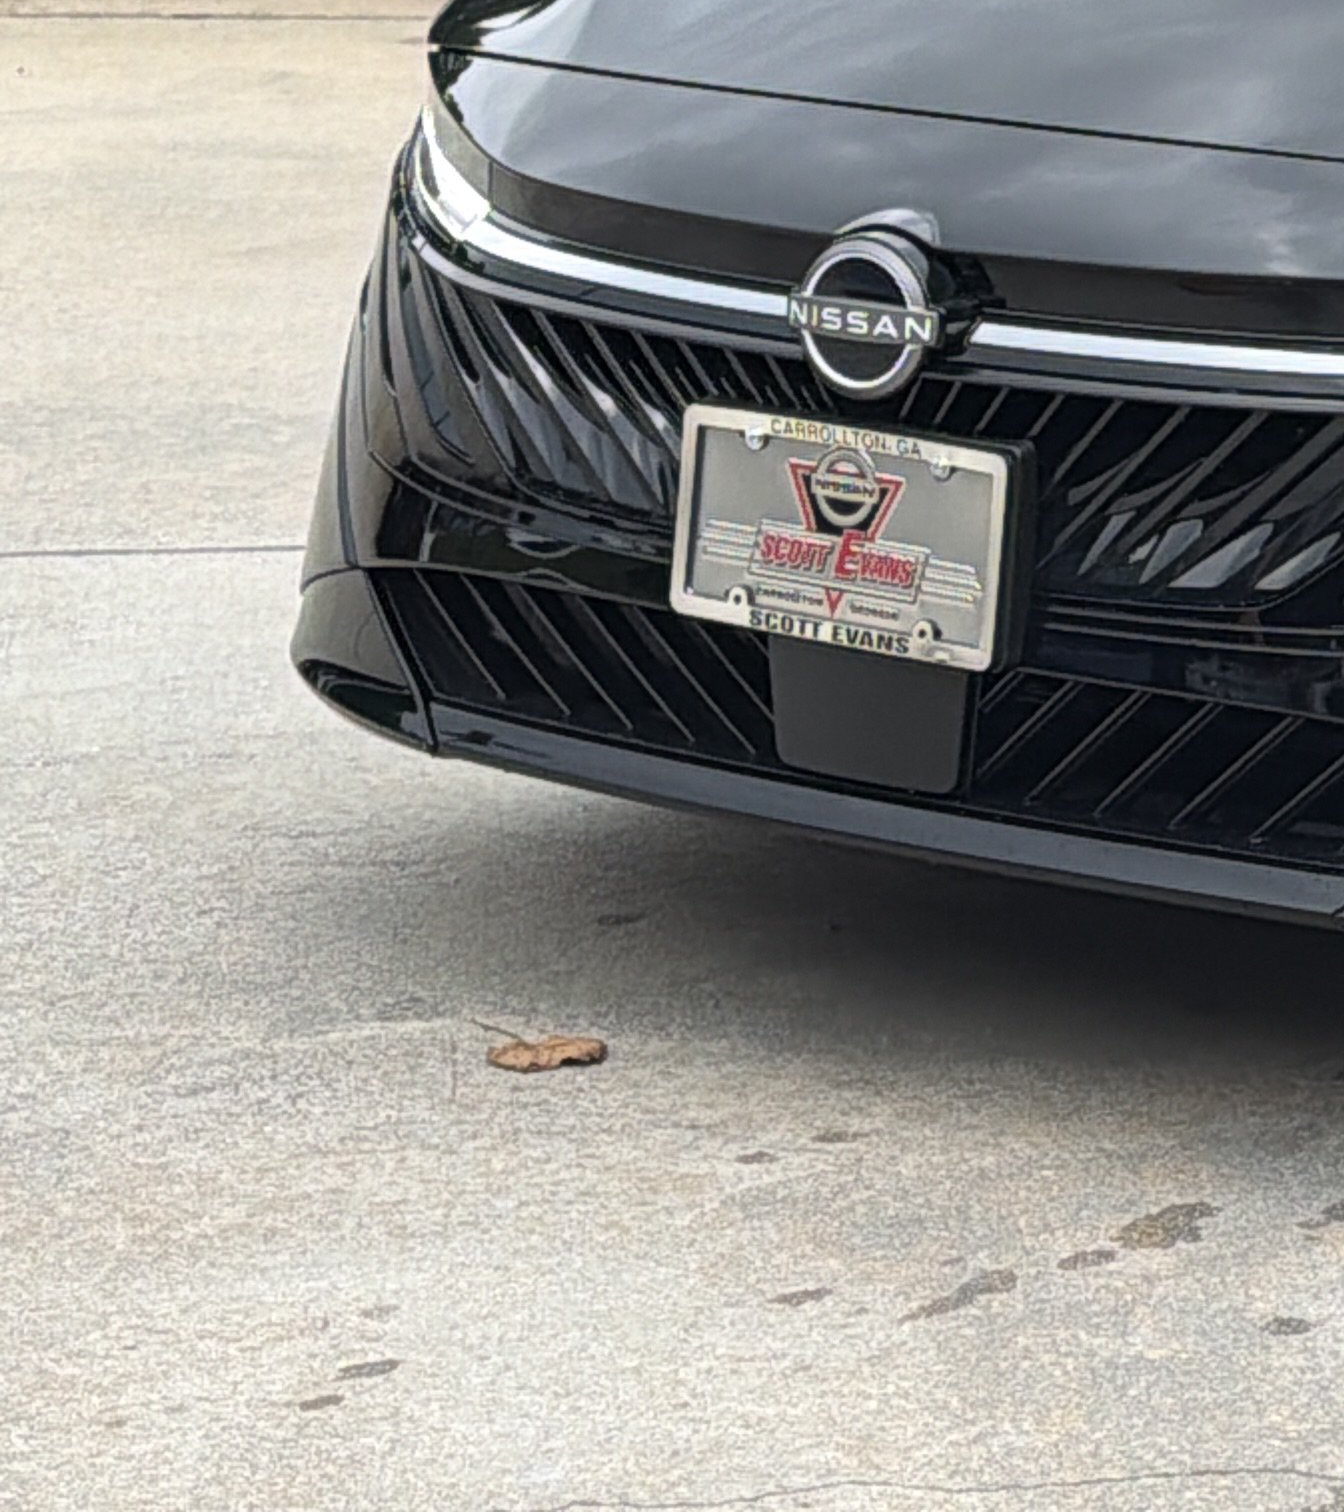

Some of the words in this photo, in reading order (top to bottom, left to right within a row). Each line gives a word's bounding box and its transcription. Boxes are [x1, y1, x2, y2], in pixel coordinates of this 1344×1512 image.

[789, 299, 931, 342] NISSAN
[897, 438, 921, 458] GA
[760, 534, 832, 572] SCOTT
[750, 610, 823, 638] SCOTT
[832, 624, 909, 654] EVANS
